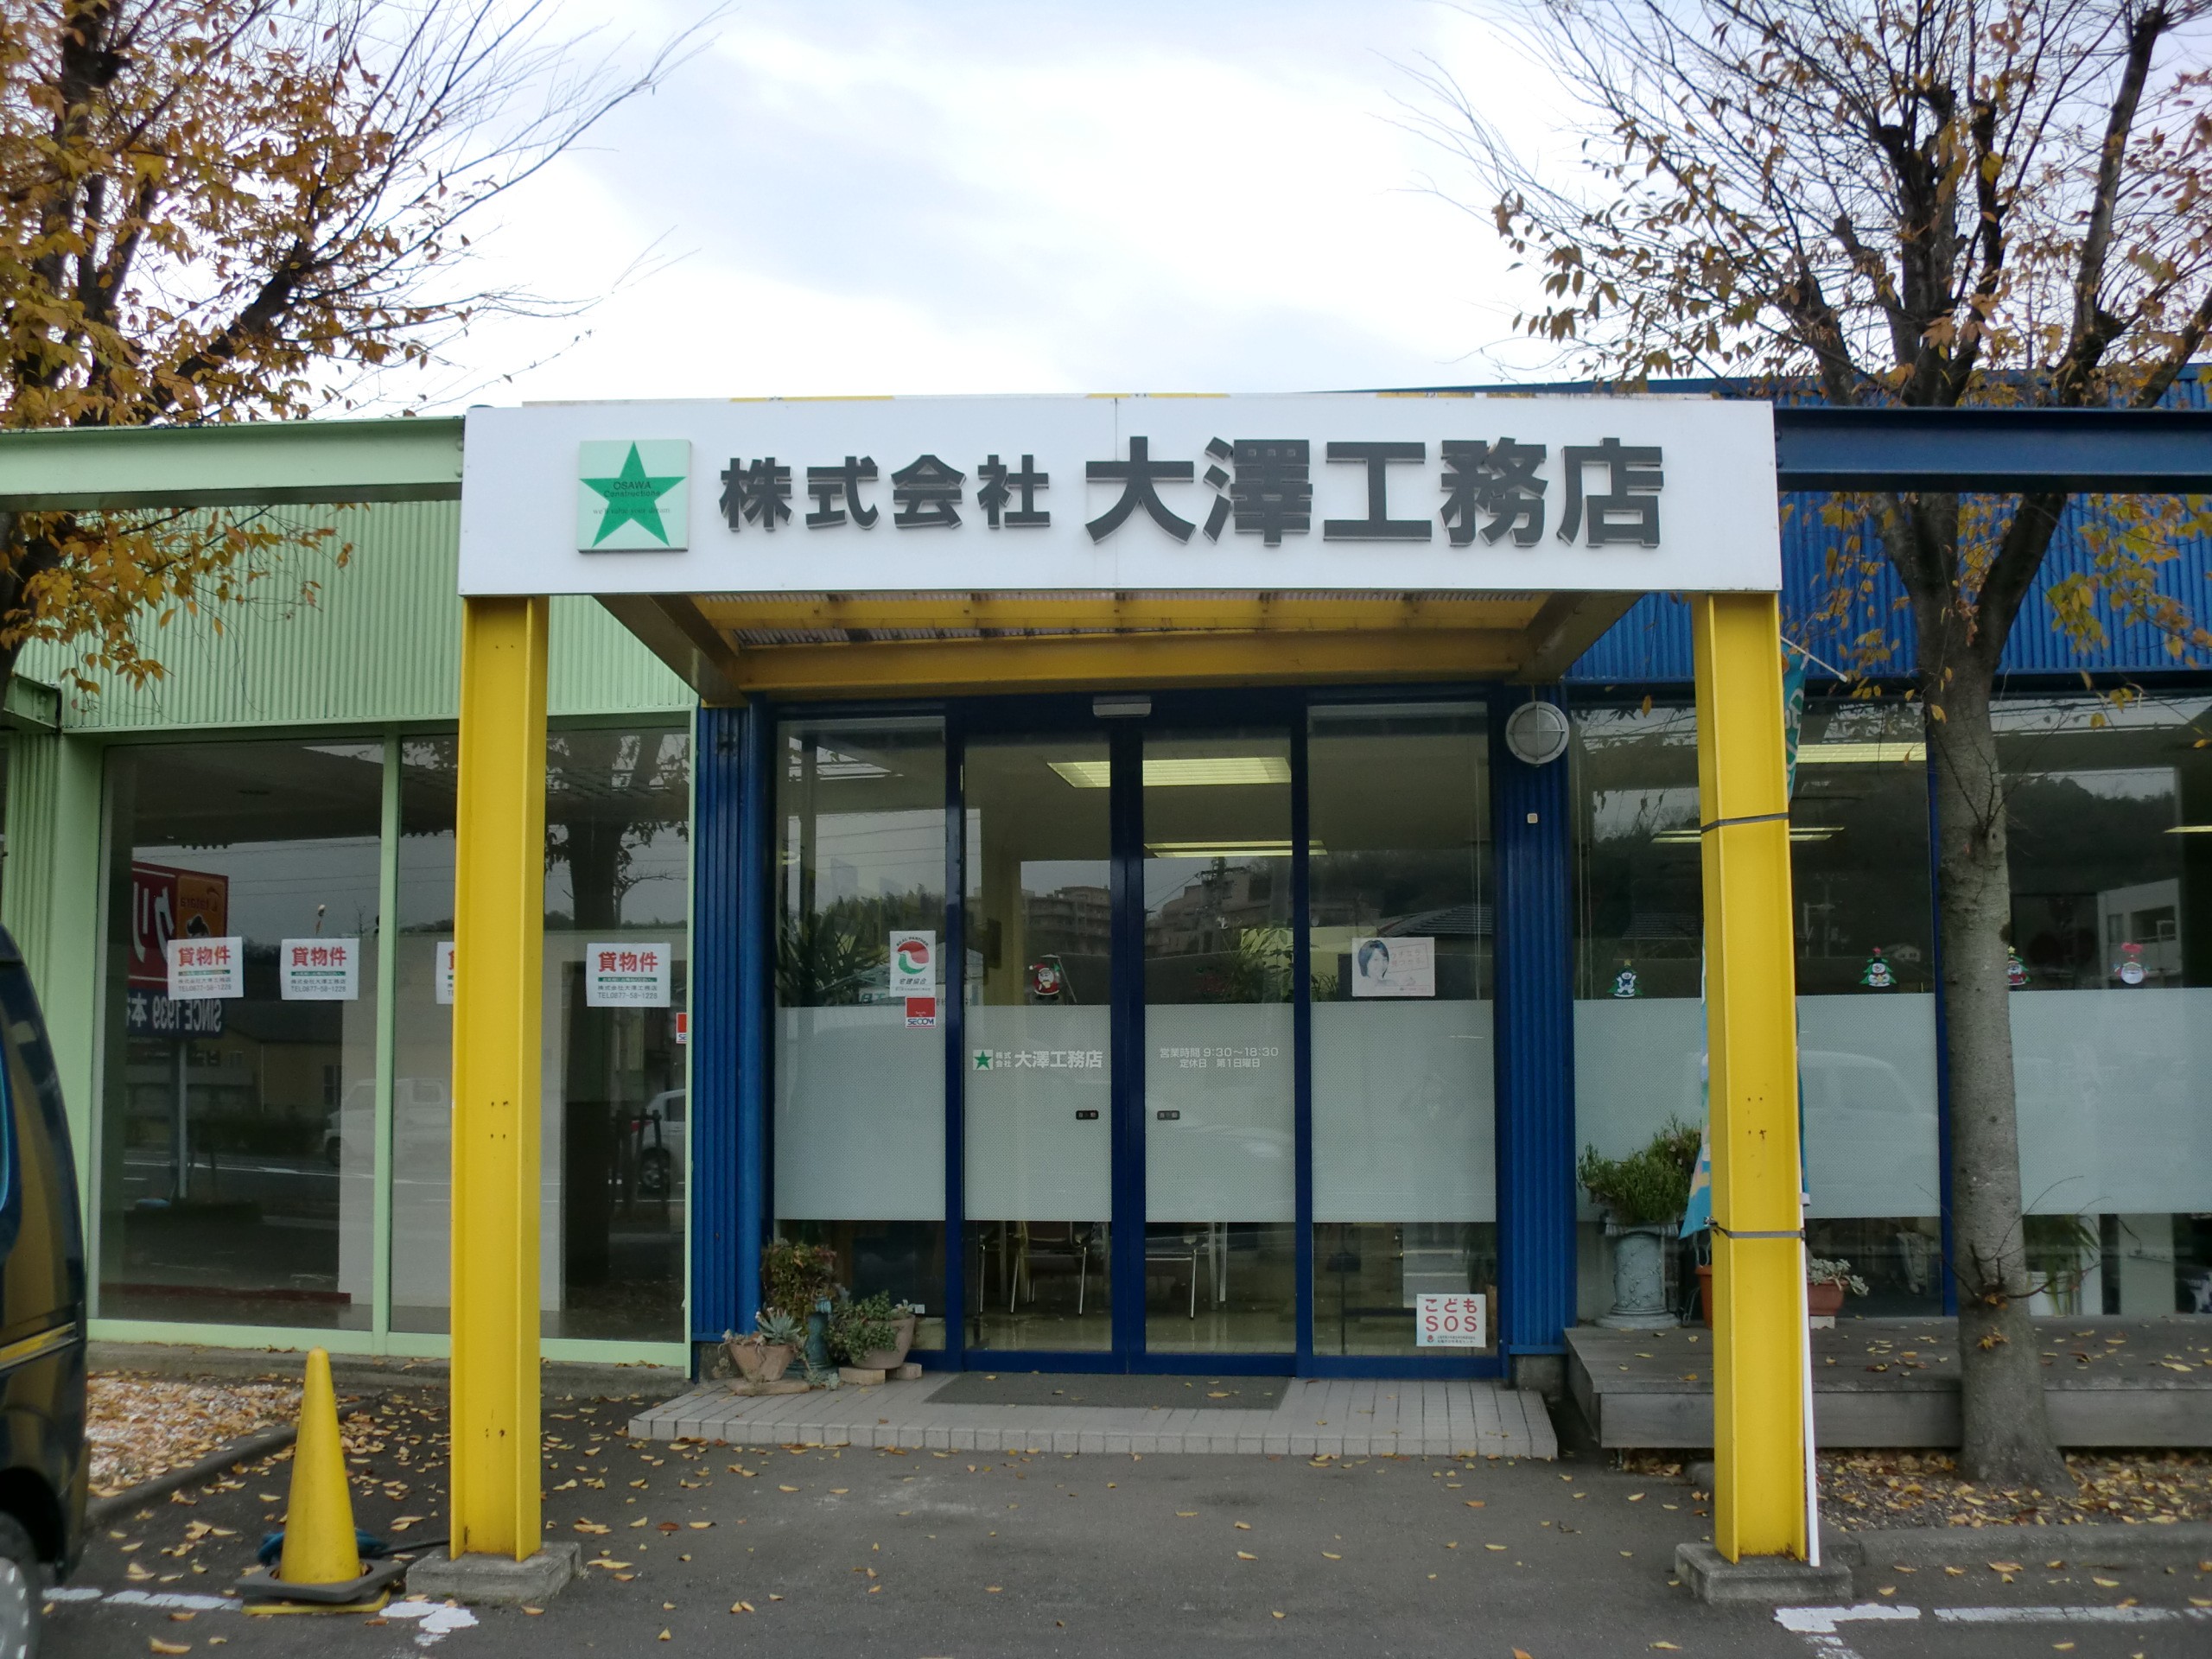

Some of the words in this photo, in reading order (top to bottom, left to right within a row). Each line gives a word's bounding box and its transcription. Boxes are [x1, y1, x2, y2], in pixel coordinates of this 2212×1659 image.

[613, 481, 652, 490] OSAWA
[178, 945, 231, 967] 貸物件
[292, 946, 346, 967] 貸物件
[598, 950, 658, 972] 貸物件
[1426, 1298, 1478, 1313] こども
[1426, 1316, 1478, 1332] SOS
